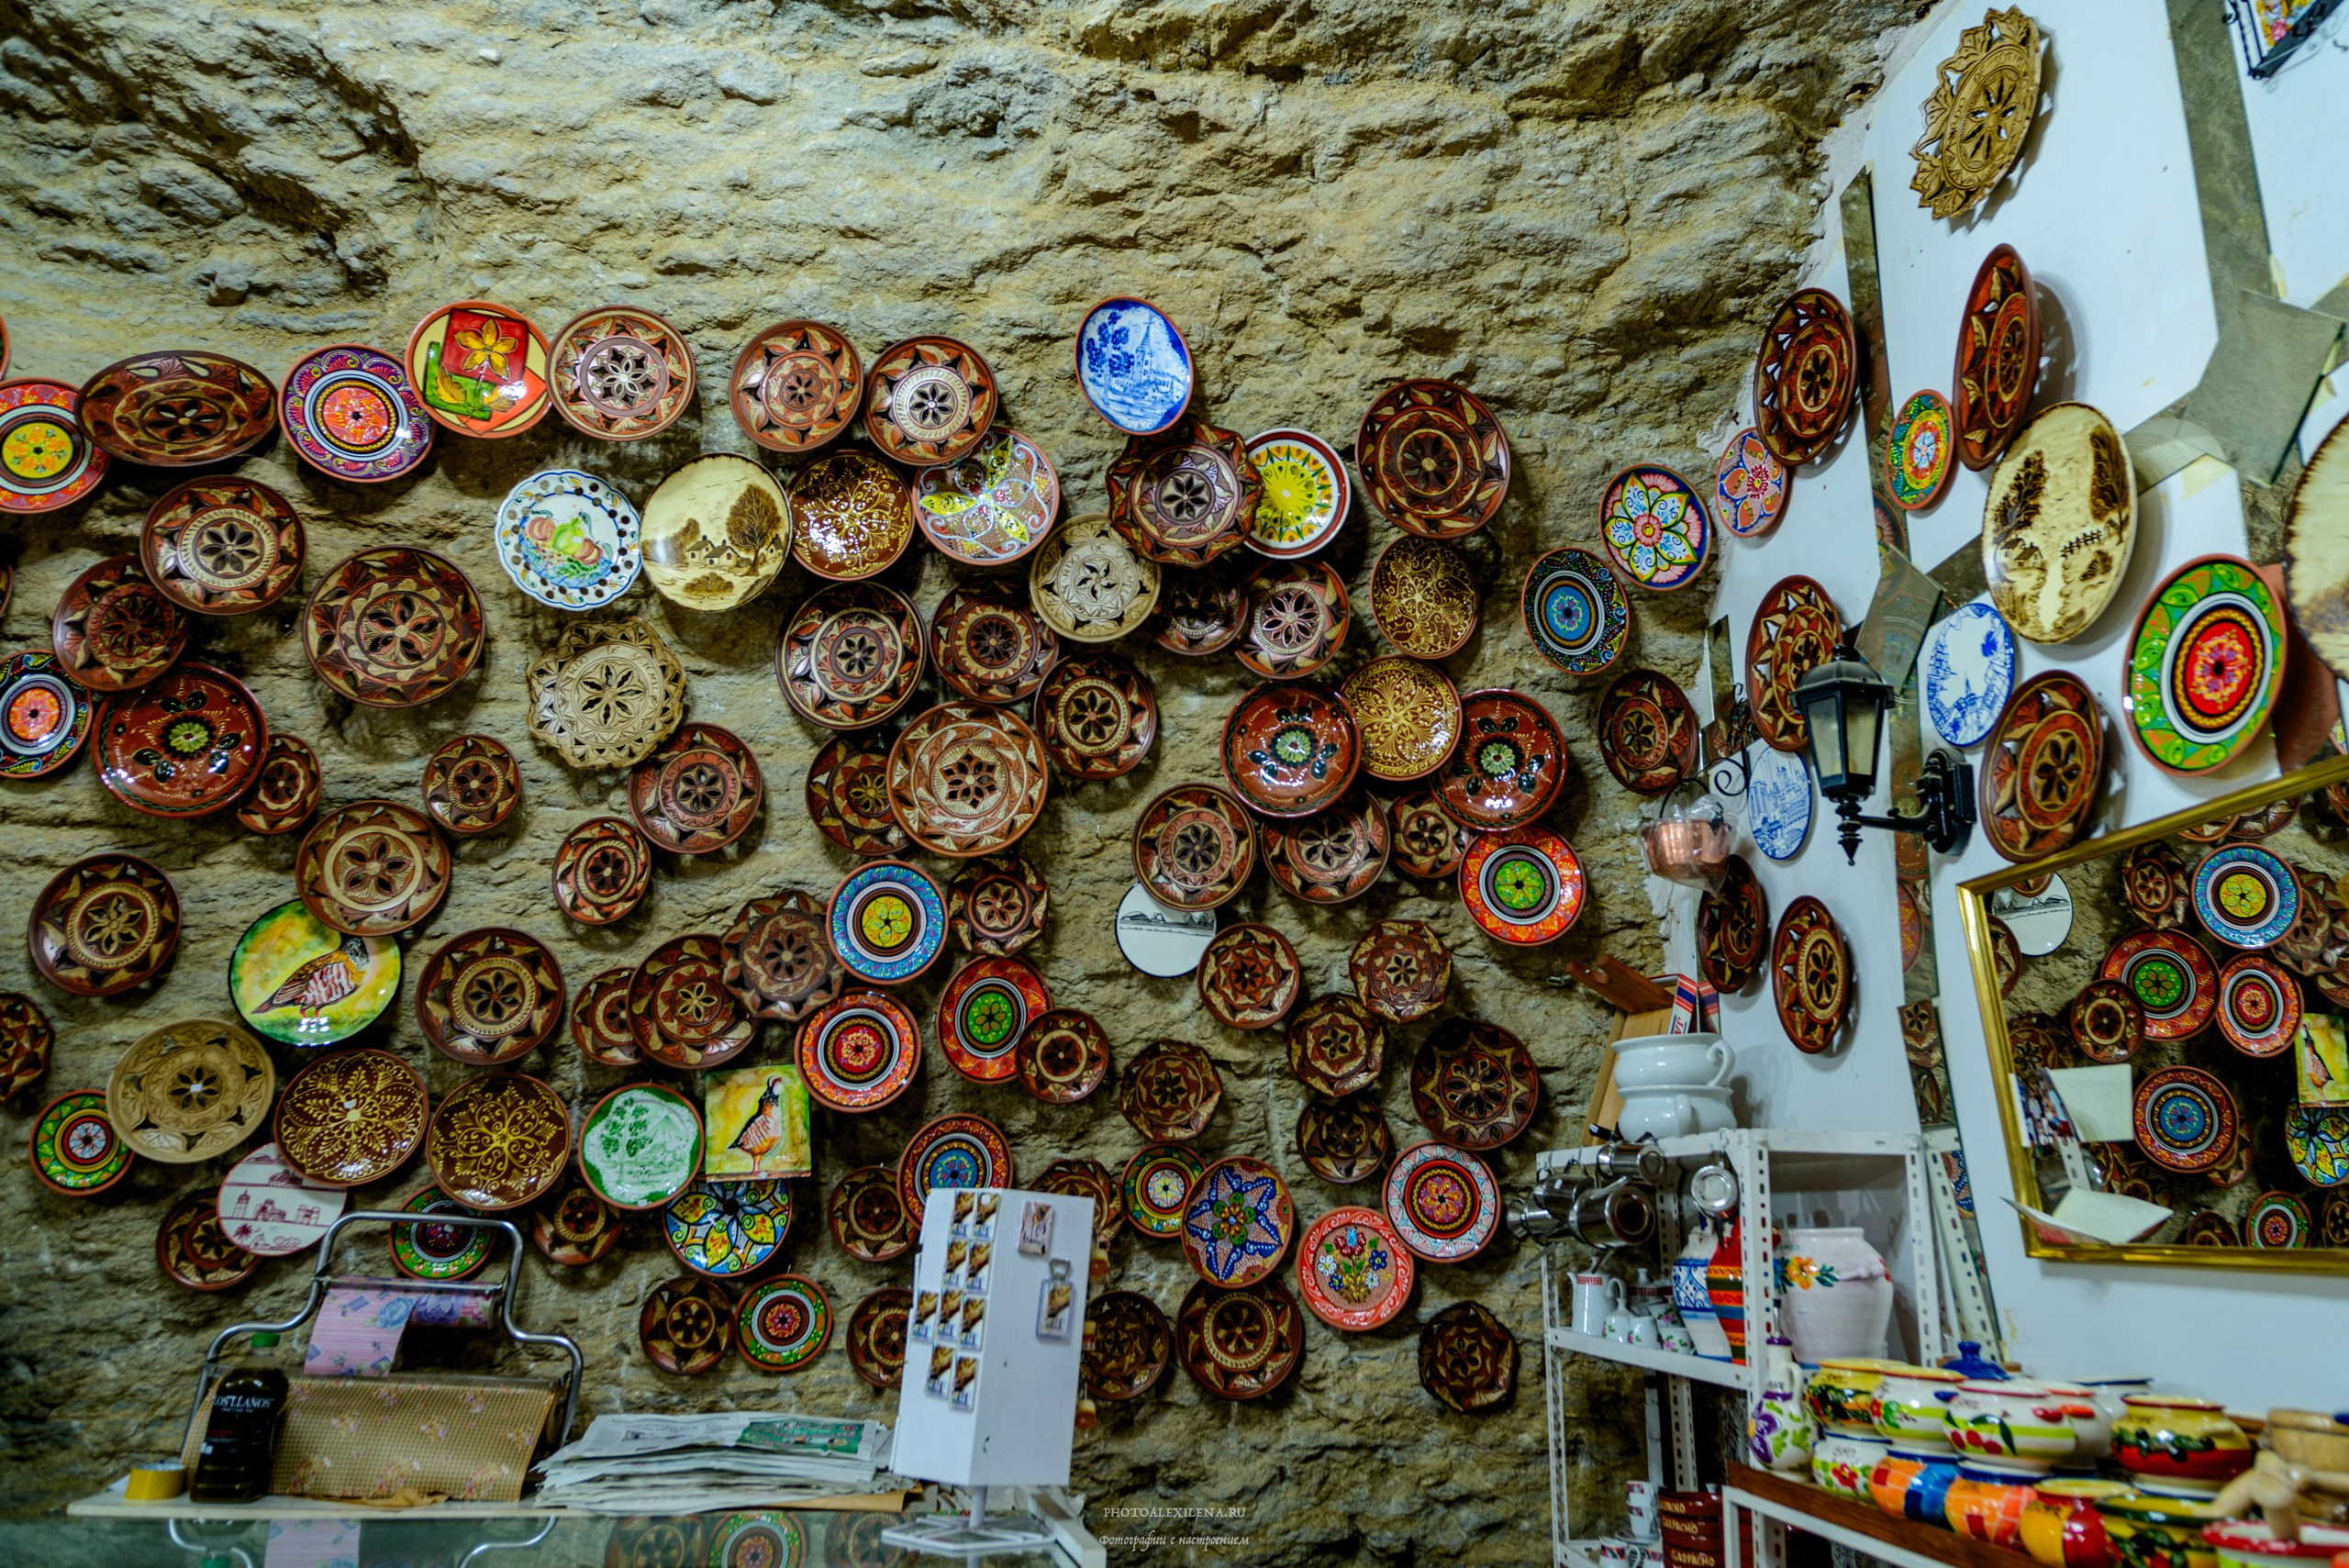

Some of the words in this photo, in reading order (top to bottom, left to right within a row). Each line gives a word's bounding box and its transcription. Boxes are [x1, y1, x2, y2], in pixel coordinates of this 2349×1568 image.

[1090, 542, 1107, 554] DE
[607, 644, 621, 655] DE
[228, 1395, 272, 1408] LLANOS
